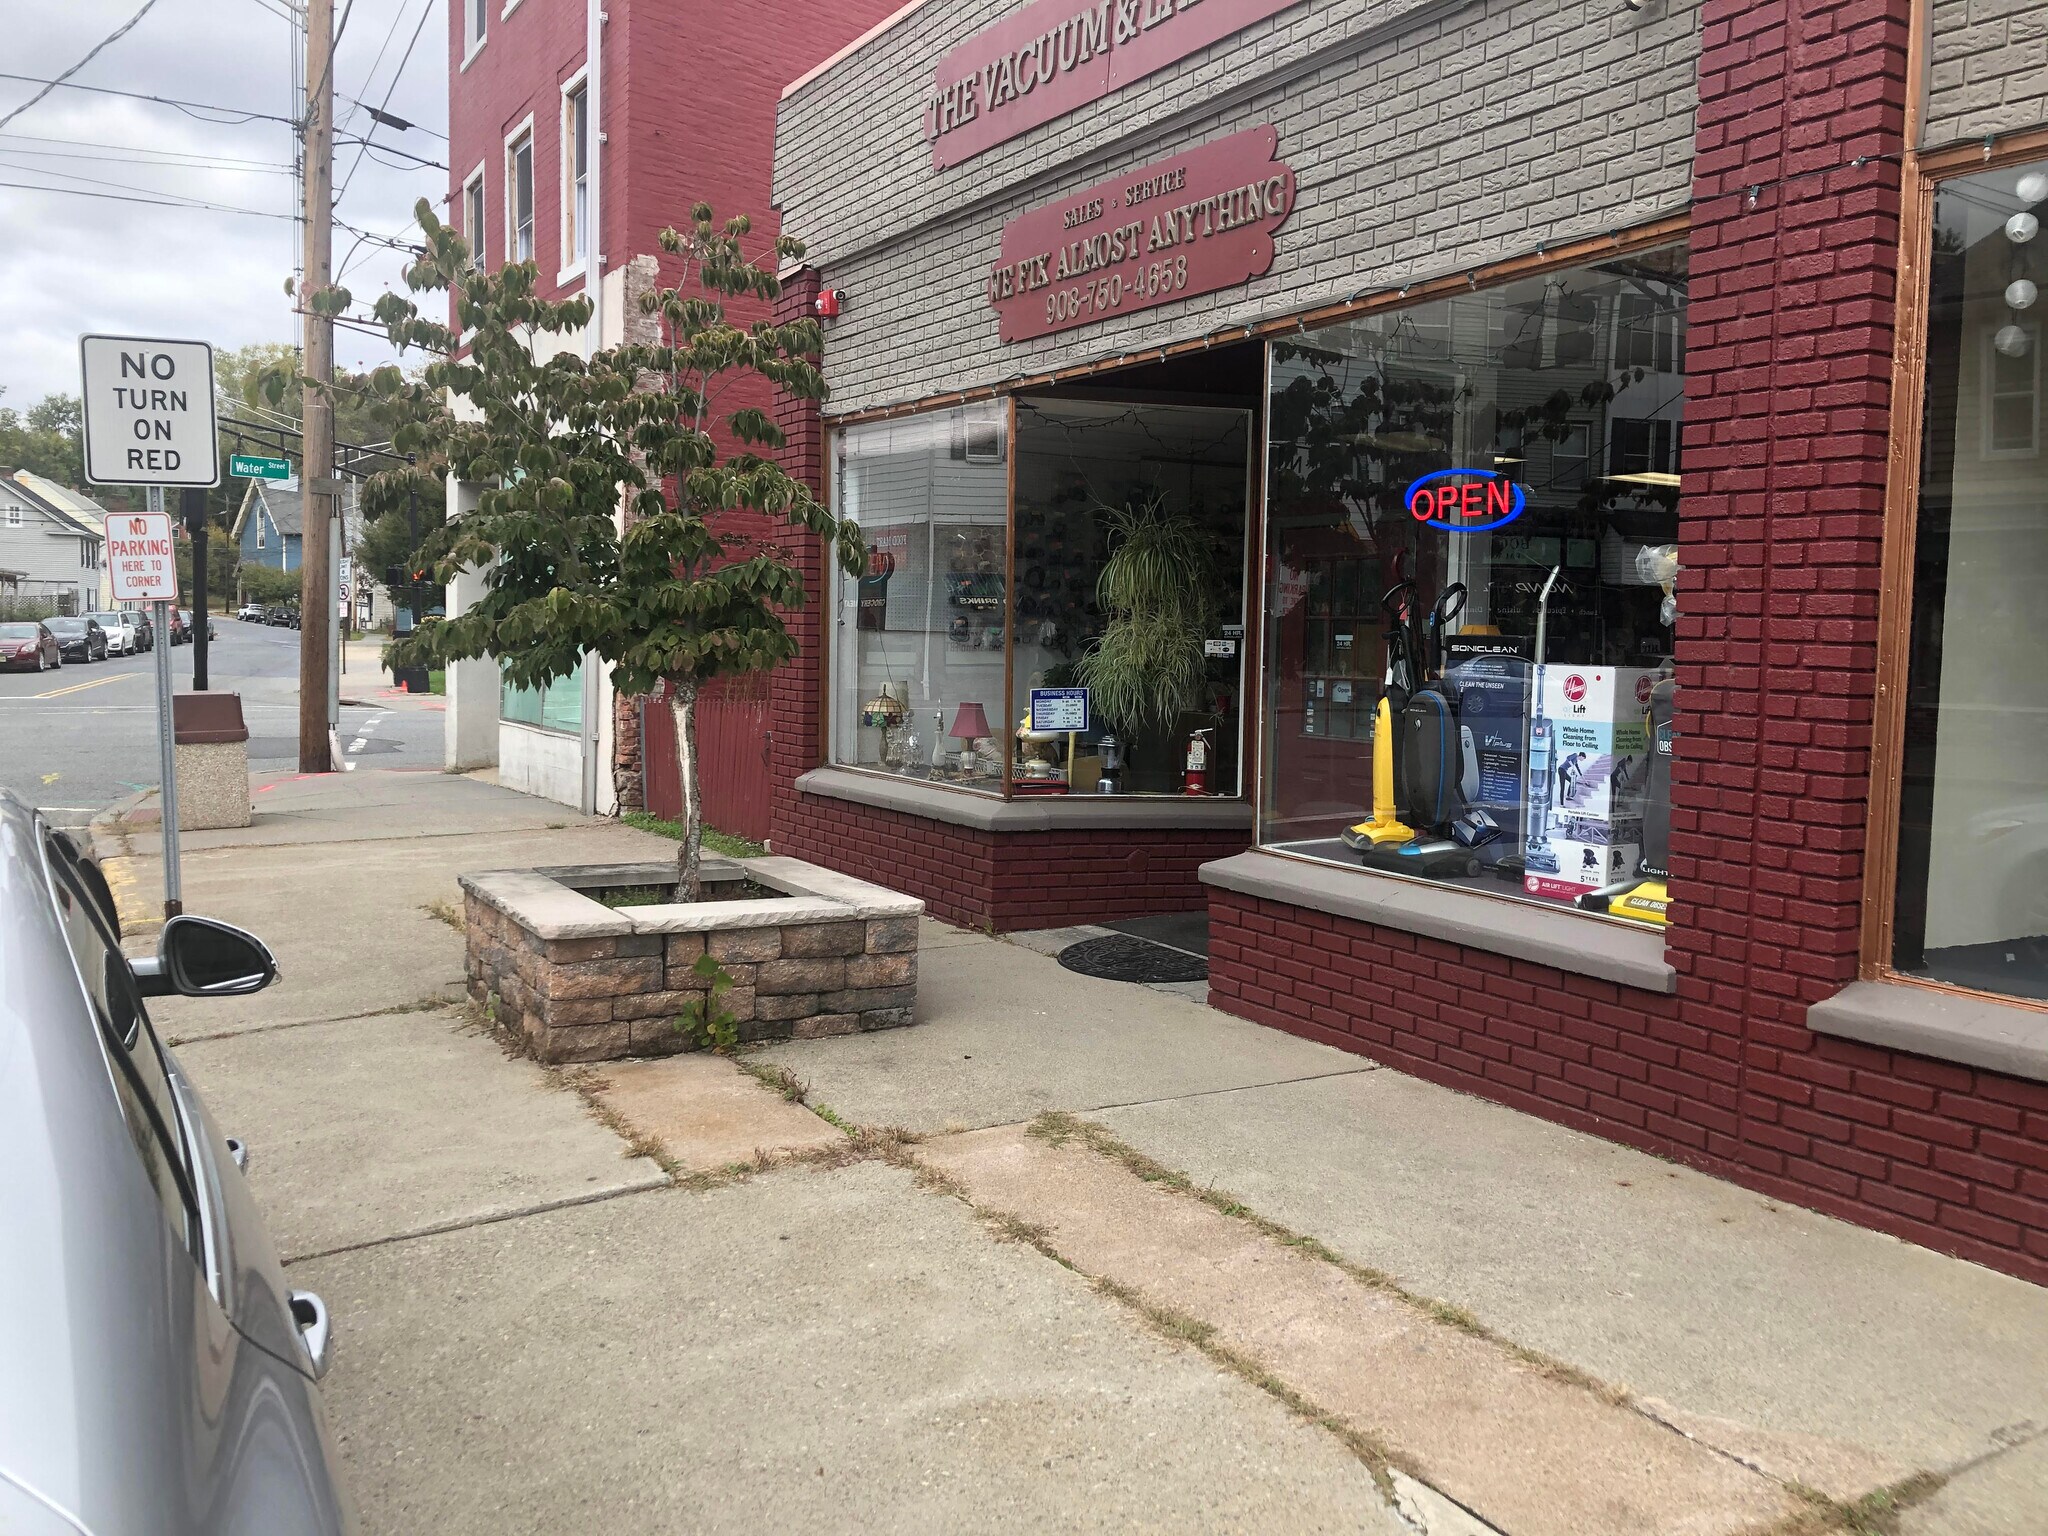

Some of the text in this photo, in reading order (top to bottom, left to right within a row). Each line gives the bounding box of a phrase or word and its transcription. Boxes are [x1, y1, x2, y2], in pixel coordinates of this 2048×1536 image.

[928, 71, 980, 141] THE
[1063, 198, 1104, 230] SALES
[1125, 167, 1187, 208] SERVICE
[1017, 252, 1053, 294] FIX
[1055, 220, 1145, 281] ALMOST
[1147, 174, 1288, 252] ANYTHING
[1046, 254, 1189, 325] 908-750-4658
[120, 351, 175, 380] NO
[112, 387, 187, 412] TURN
[133, 418, 172, 440] ON
[127, 448, 181, 471] RED
[235, 461, 286, 475] Water Street
[1411, 480, 1510, 521] OPEN
[129, 518, 147, 536] NO
[111, 539, 169, 557] PARKING
[122, 560, 162, 572] HERE TO
[126, 576, 162, 588] CORNER
[1573, 704, 1586, 713] Lift
[1582, 742, 1598, 750] Ceiling
[1631, 897, 1650, 907] CLEAN
